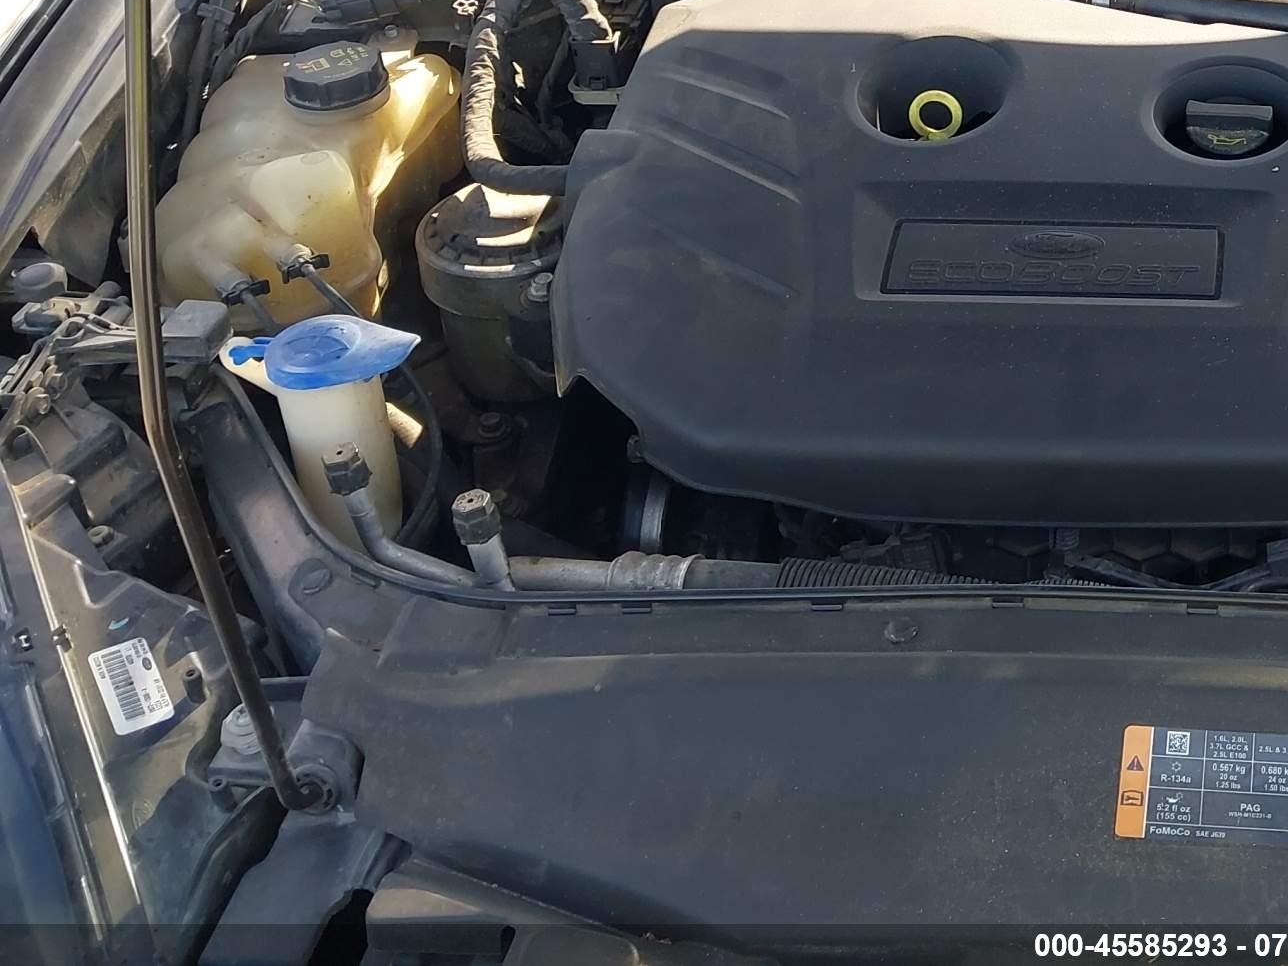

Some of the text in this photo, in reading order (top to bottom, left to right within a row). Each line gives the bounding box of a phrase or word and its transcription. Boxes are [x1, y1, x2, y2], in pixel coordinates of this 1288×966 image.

[906, 259, 1200, 286] ECOBOOST
[1225, 743, 1242, 751] GCC
[1212, 763, 1246, 775] 0.567 kg
[1260, 765, 1283, 775] 0.680
[1160, 773, 1192, 784] R-134a
[1268, 776, 1277, 784] 24
[1215, 781, 1241, 789] 1.25 lbs
[1171, 804, 1178, 812] fl
[1180, 805, 1191, 813] oz
[1239, 803, 1261, 813] PAG
[1156, 811, 1192, 822] (155 cc)
[1149, 825, 1191, 836] FoMoCo
